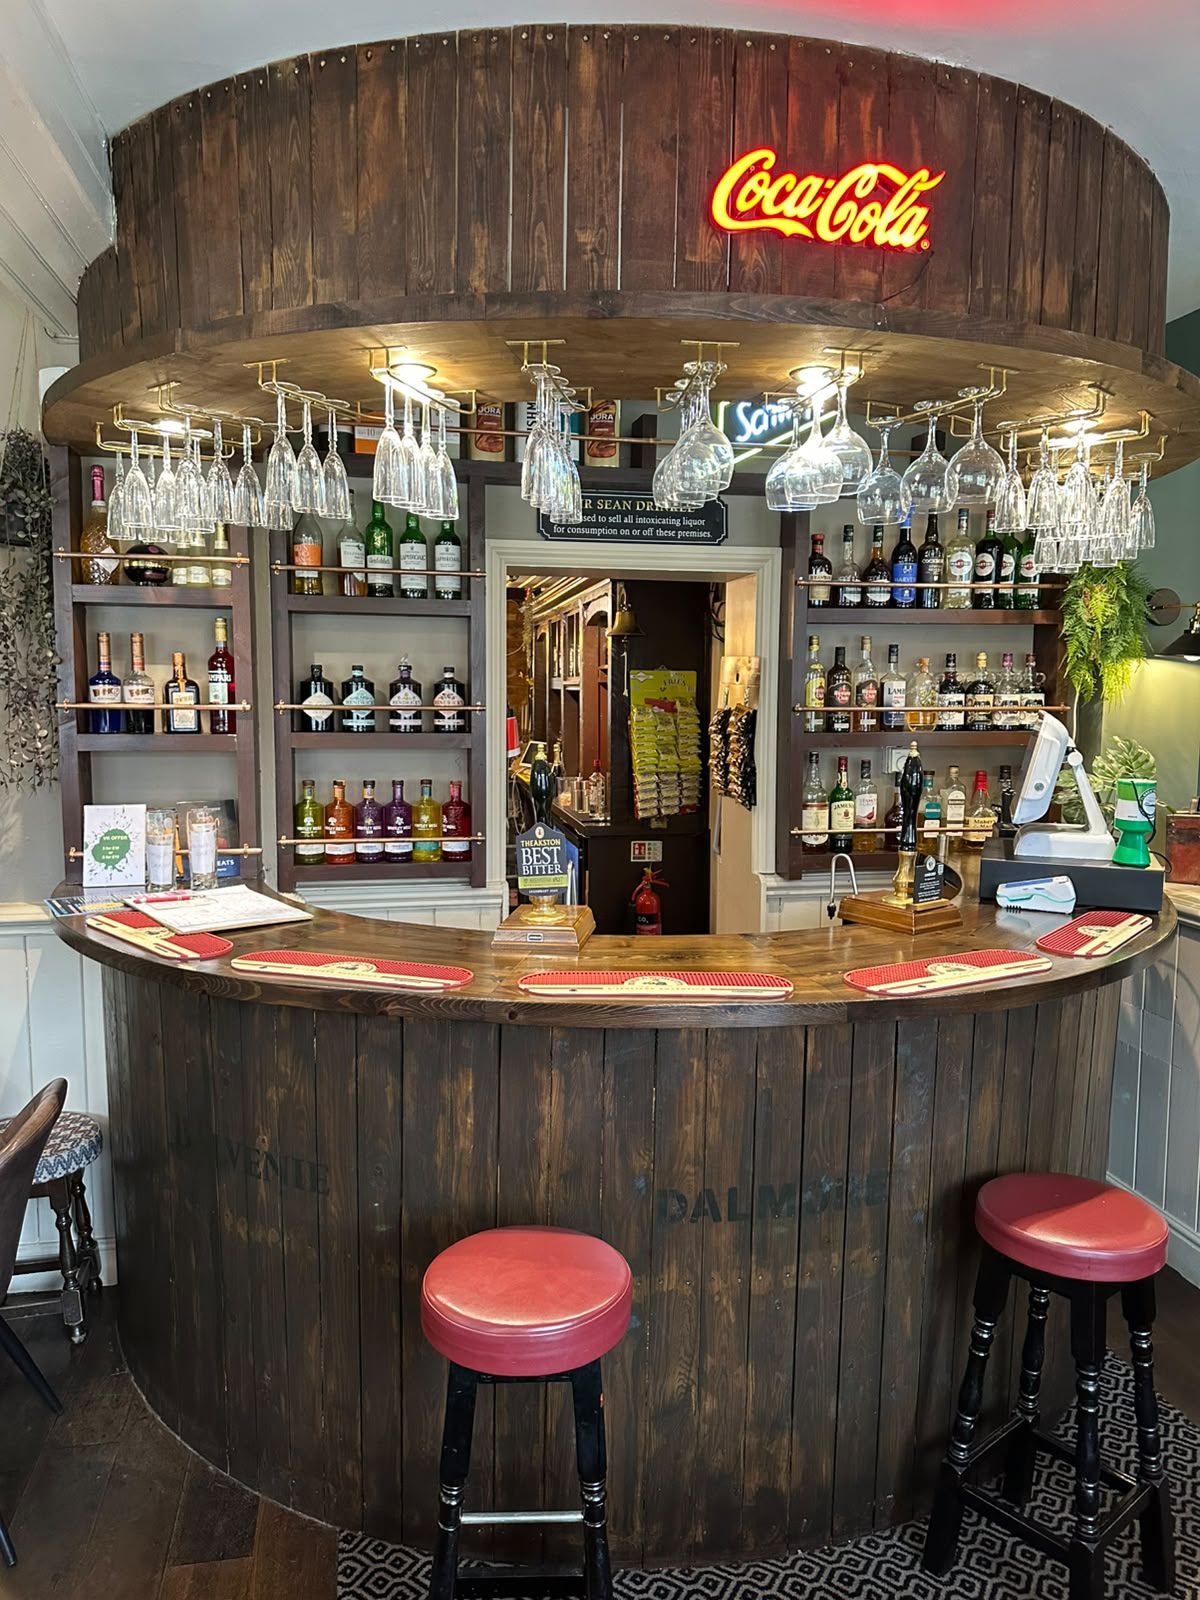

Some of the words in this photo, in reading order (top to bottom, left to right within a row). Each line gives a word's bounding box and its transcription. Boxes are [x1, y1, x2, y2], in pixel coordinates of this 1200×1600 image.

[711, 147, 946, 249] Coca-Cola
[597, 499, 632, 511] SEAN
[598, 514, 607, 523] to
[608, 514, 622, 524] sell
[624, 514, 634, 524] all
[635, 514, 681, 527] intoxicating
[683, 516, 706, 528] liquor
[553, 524, 565, 534] for
[567, 525, 617, 537] consumption
[620, 528, 630, 536] on
[632, 528, 641, 537] or
[642, 527, 653, 536] off
[656, 528, 676, 537] these
[677, 529, 713, 540] premises.
[520, 839, 561, 847] THEAKSTON
[521, 846, 561, 866] BEST
[522, 864, 564, 876] BITTER
